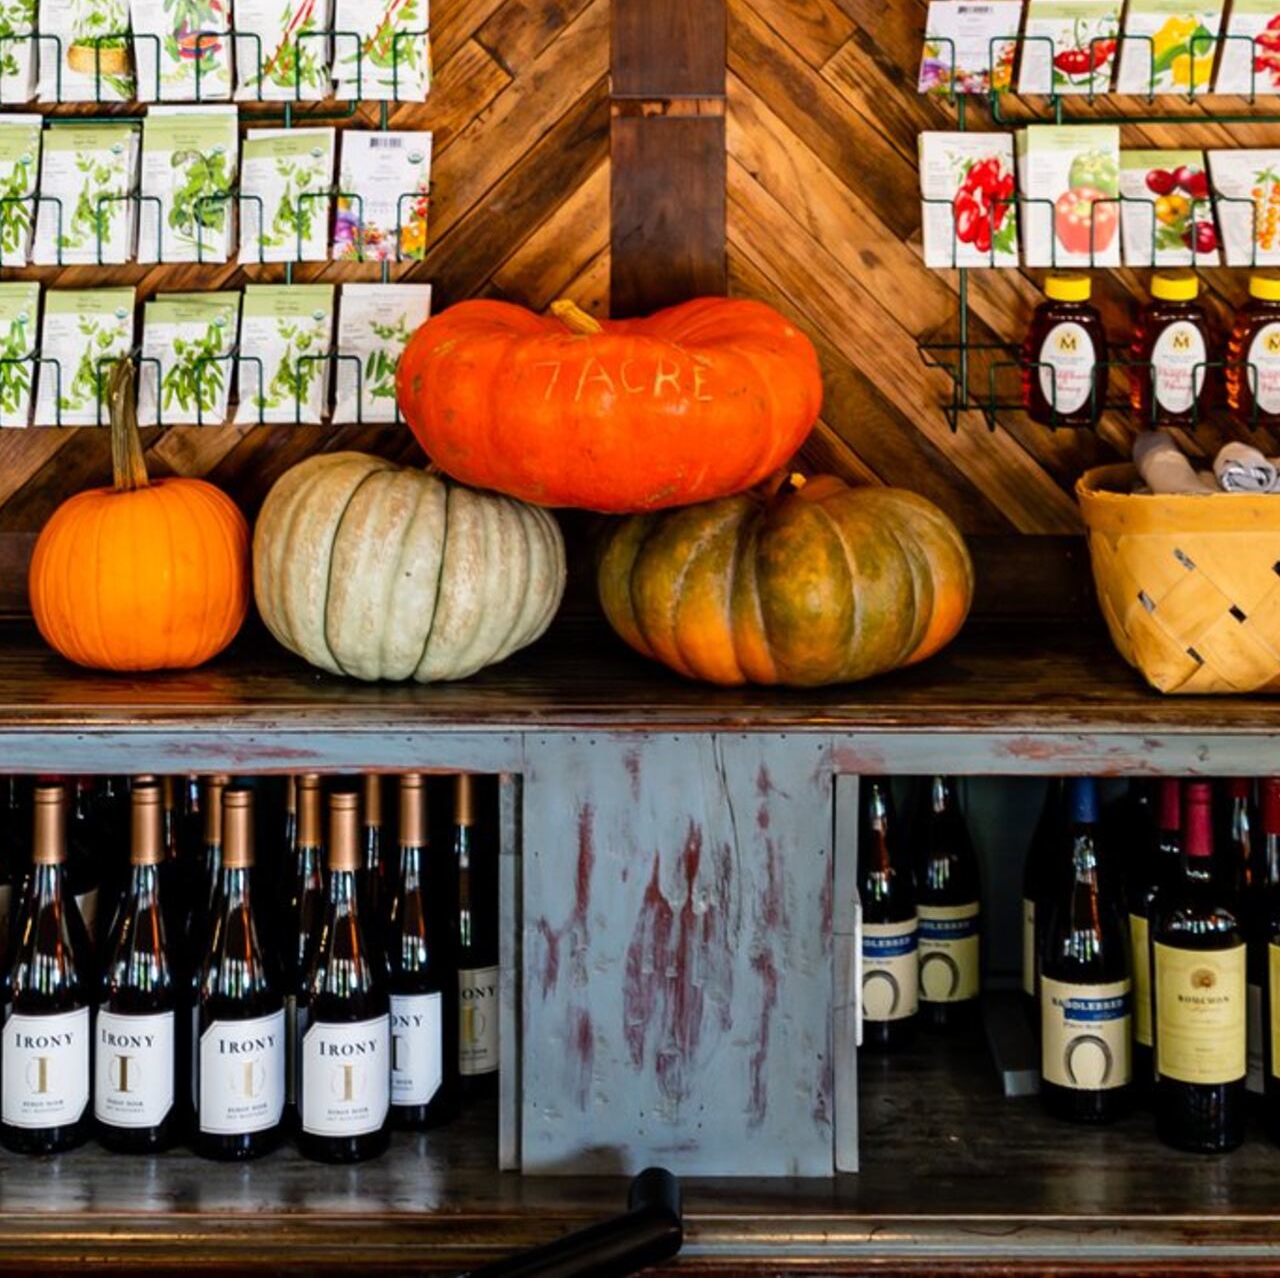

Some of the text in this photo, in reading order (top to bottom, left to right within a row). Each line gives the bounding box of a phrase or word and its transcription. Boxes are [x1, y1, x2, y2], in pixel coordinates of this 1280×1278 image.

[574, 356, 714, 402] ACRE
[462, 985, 497, 1001] ONY
[392, 1014, 424, 1027] ONY
[15, 1032, 74, 1049] IRONY
[102, 1029, 155, 1048] IRONY
[220, 1035, 276, 1054] IRONY
[319, 1038, 378, 1056] IRONY
